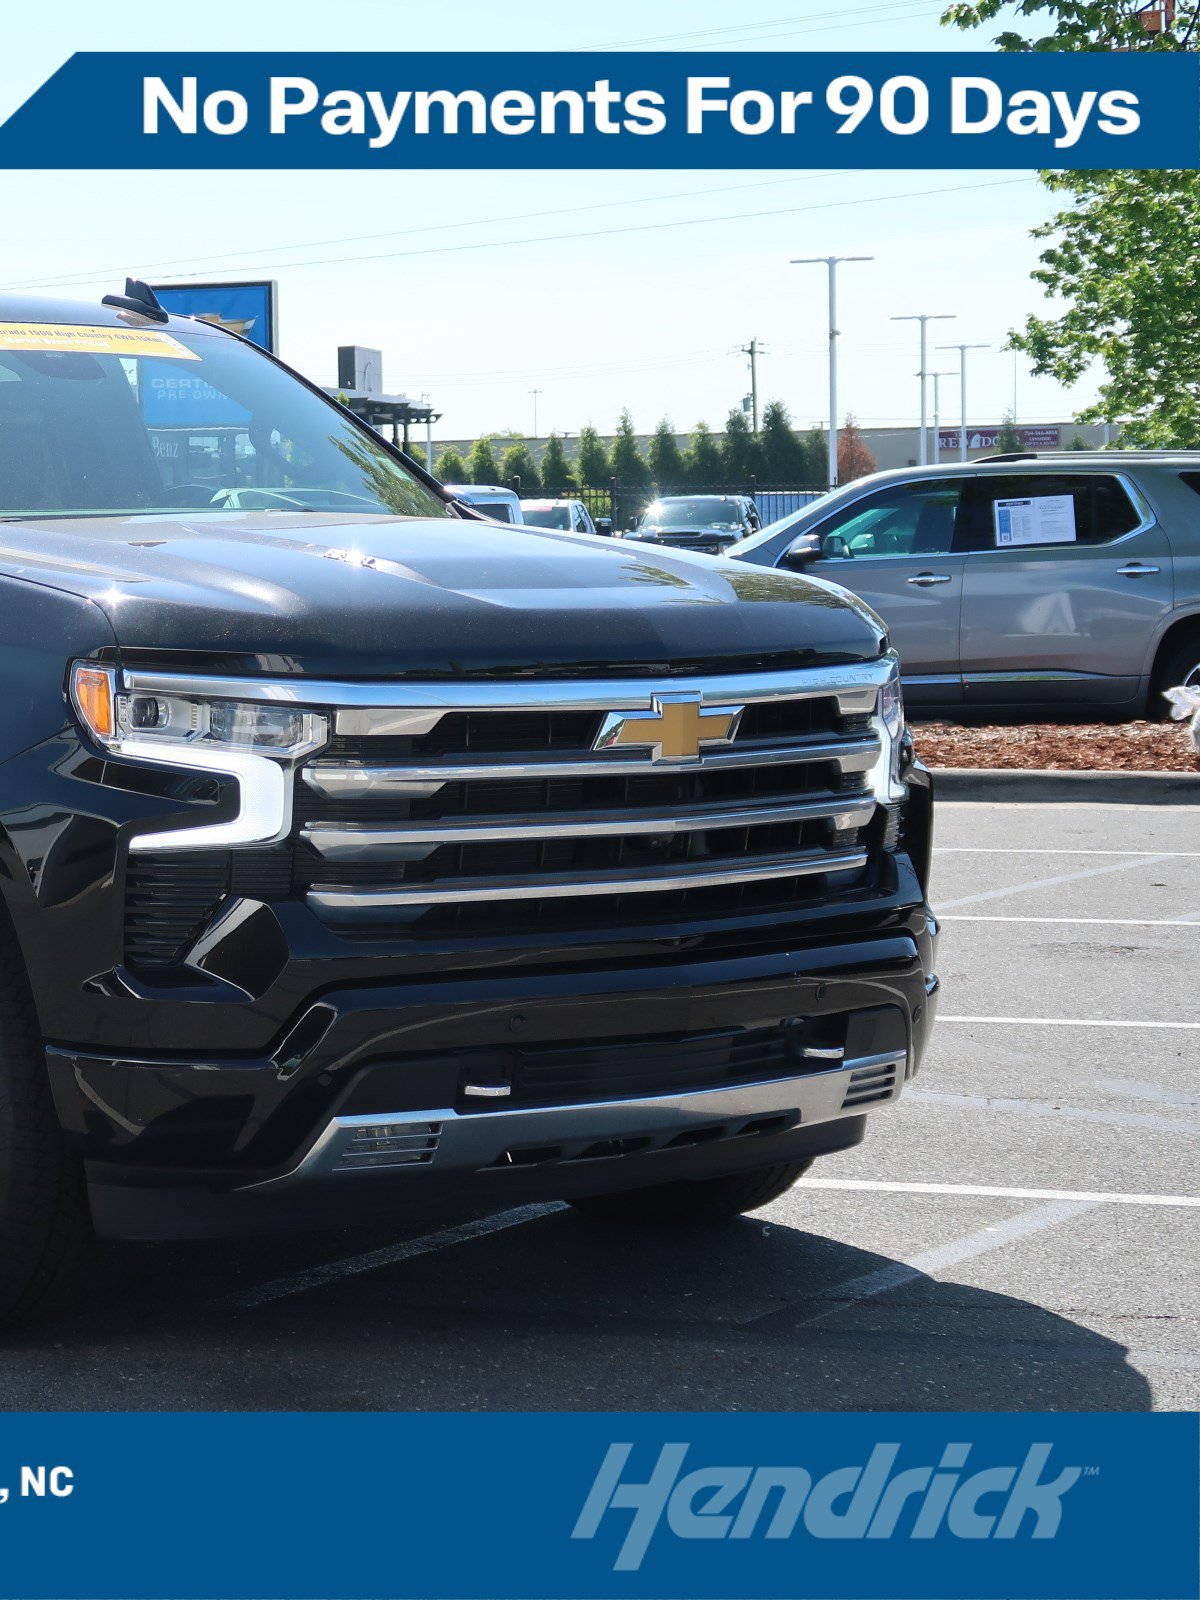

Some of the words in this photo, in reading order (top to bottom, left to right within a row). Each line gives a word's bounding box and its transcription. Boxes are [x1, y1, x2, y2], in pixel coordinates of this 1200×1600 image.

[28, 329, 52, 337] 1500
[53, 330, 77, 339] High
[77, 331, 113, 341] Country
[829, 673, 875, 685] COUNTRY
